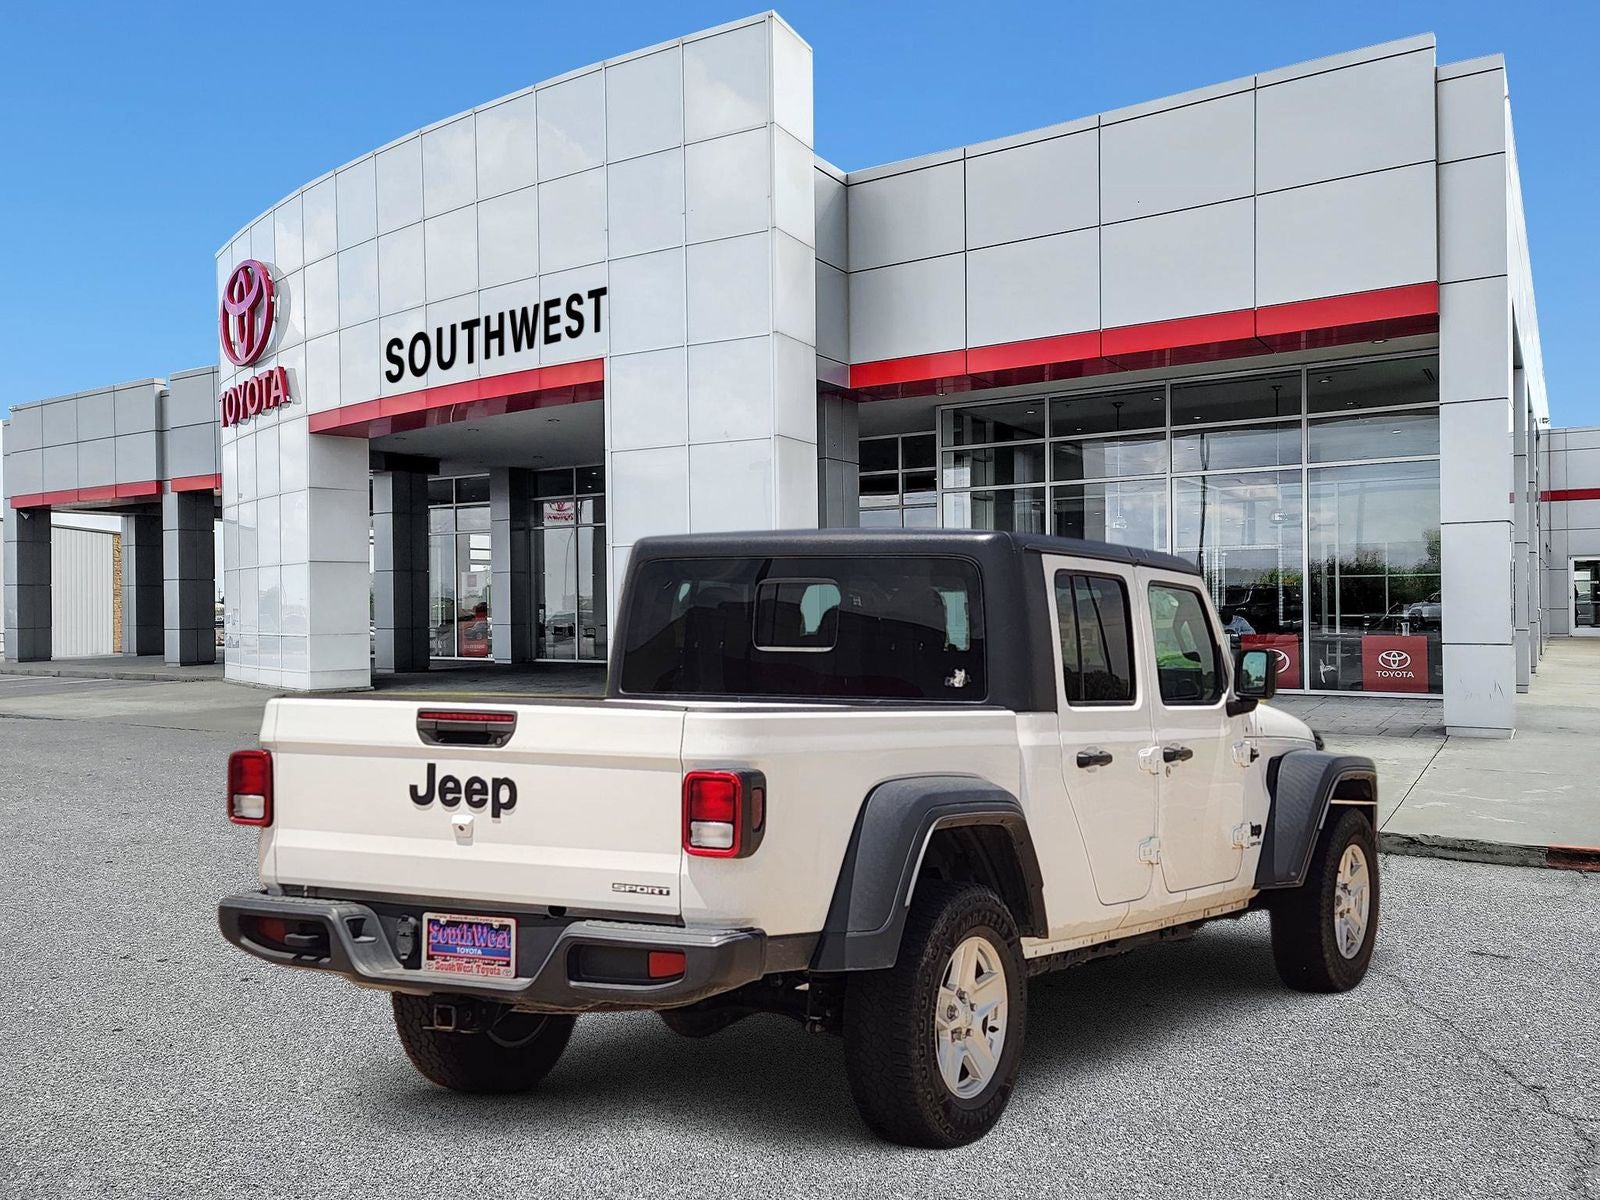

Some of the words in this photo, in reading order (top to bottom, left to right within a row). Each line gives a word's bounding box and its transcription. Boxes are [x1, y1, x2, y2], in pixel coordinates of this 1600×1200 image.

[385, 286, 608, 384] SOUTHWEST
[219, 366, 290, 428] TOYOTA
[1376, 670, 1415, 678] TOYOTA
[409, 762, 518, 819] Jeep
[612, 882, 671, 897] SPORT
[456, 947, 482, 955] TOYOTA
[475, 964, 501, 976] Toyota
